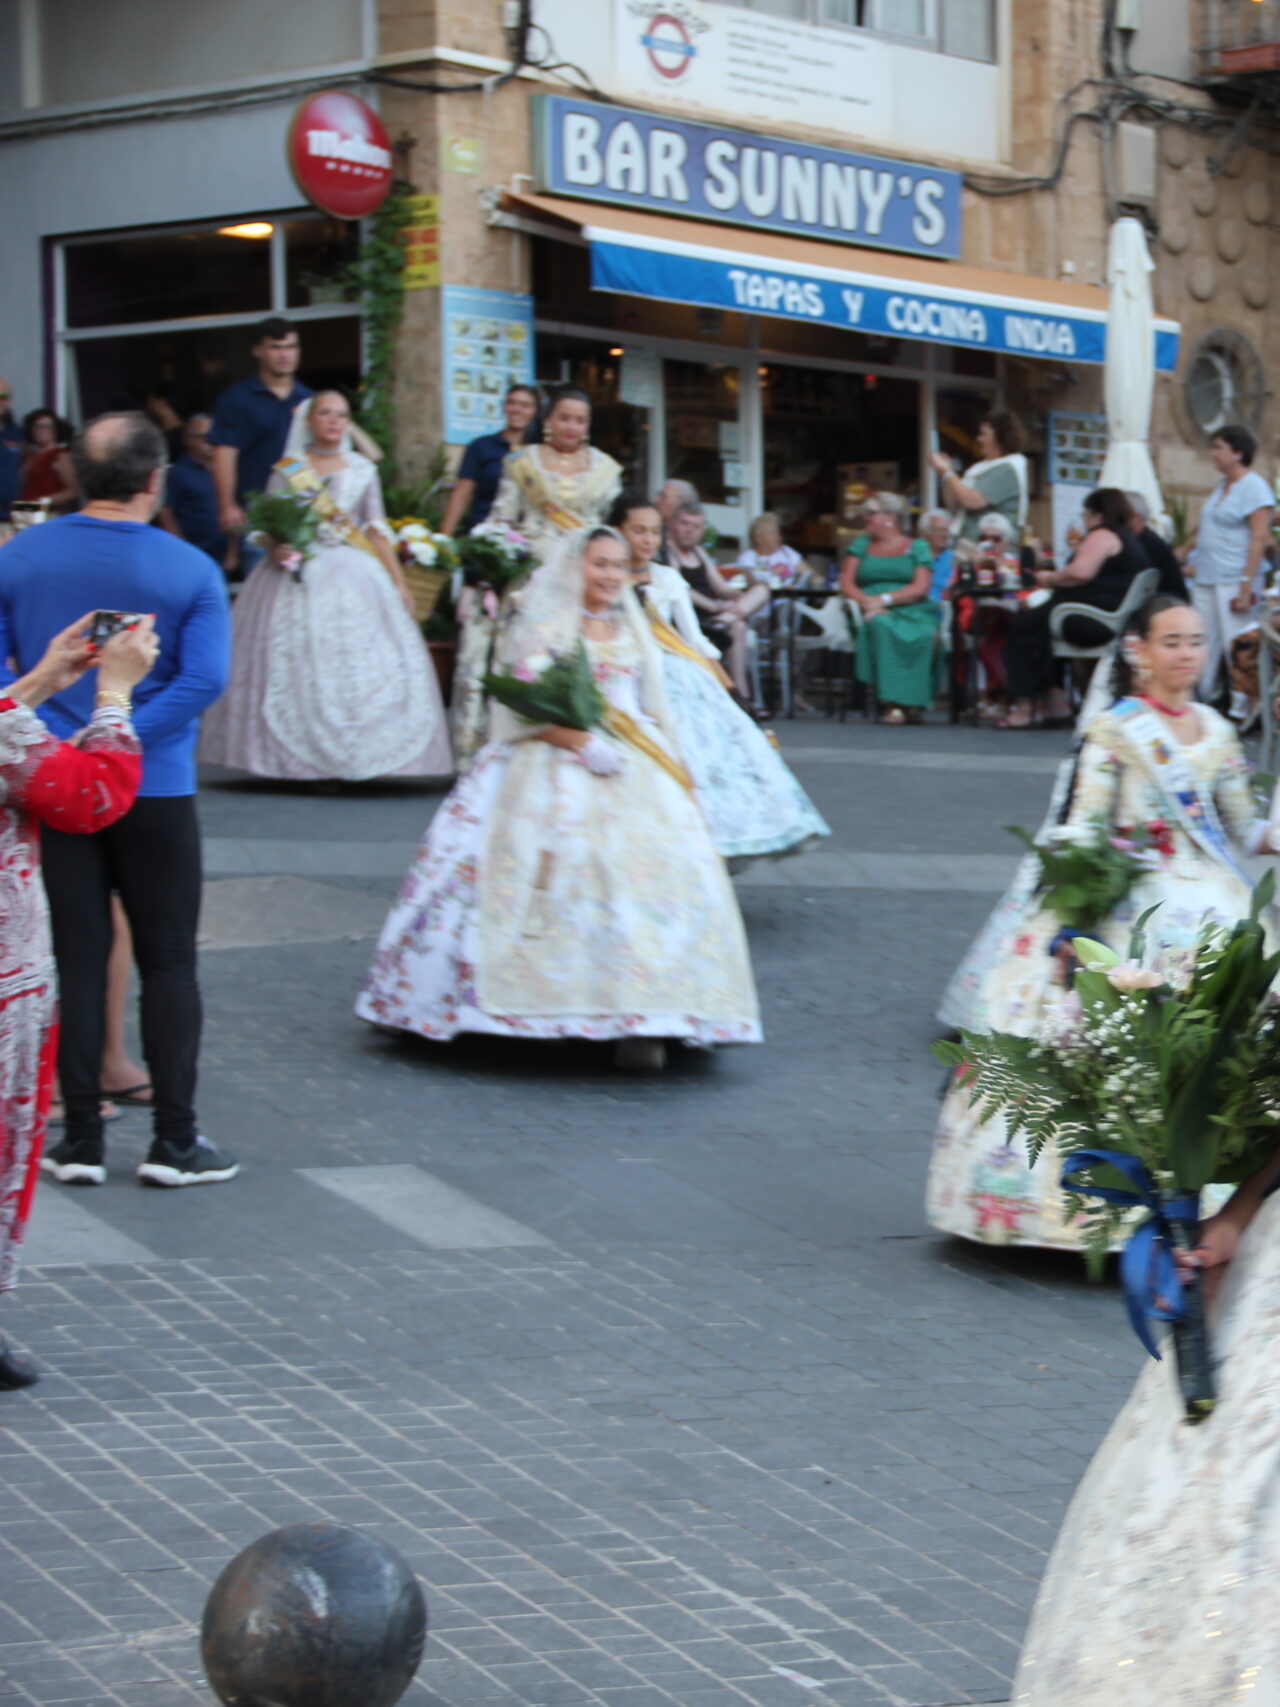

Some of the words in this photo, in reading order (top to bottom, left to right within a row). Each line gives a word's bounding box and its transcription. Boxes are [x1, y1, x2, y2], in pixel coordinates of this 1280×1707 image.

[562, 112, 690, 203] BAR
[703, 138, 947, 247] SUNNY'S
[728, 269, 825, 318] TAPAS
[842, 289, 864, 324] Y
[886, 297, 987, 343] COCINA
[1004, 314, 1076, 355] INDIA
